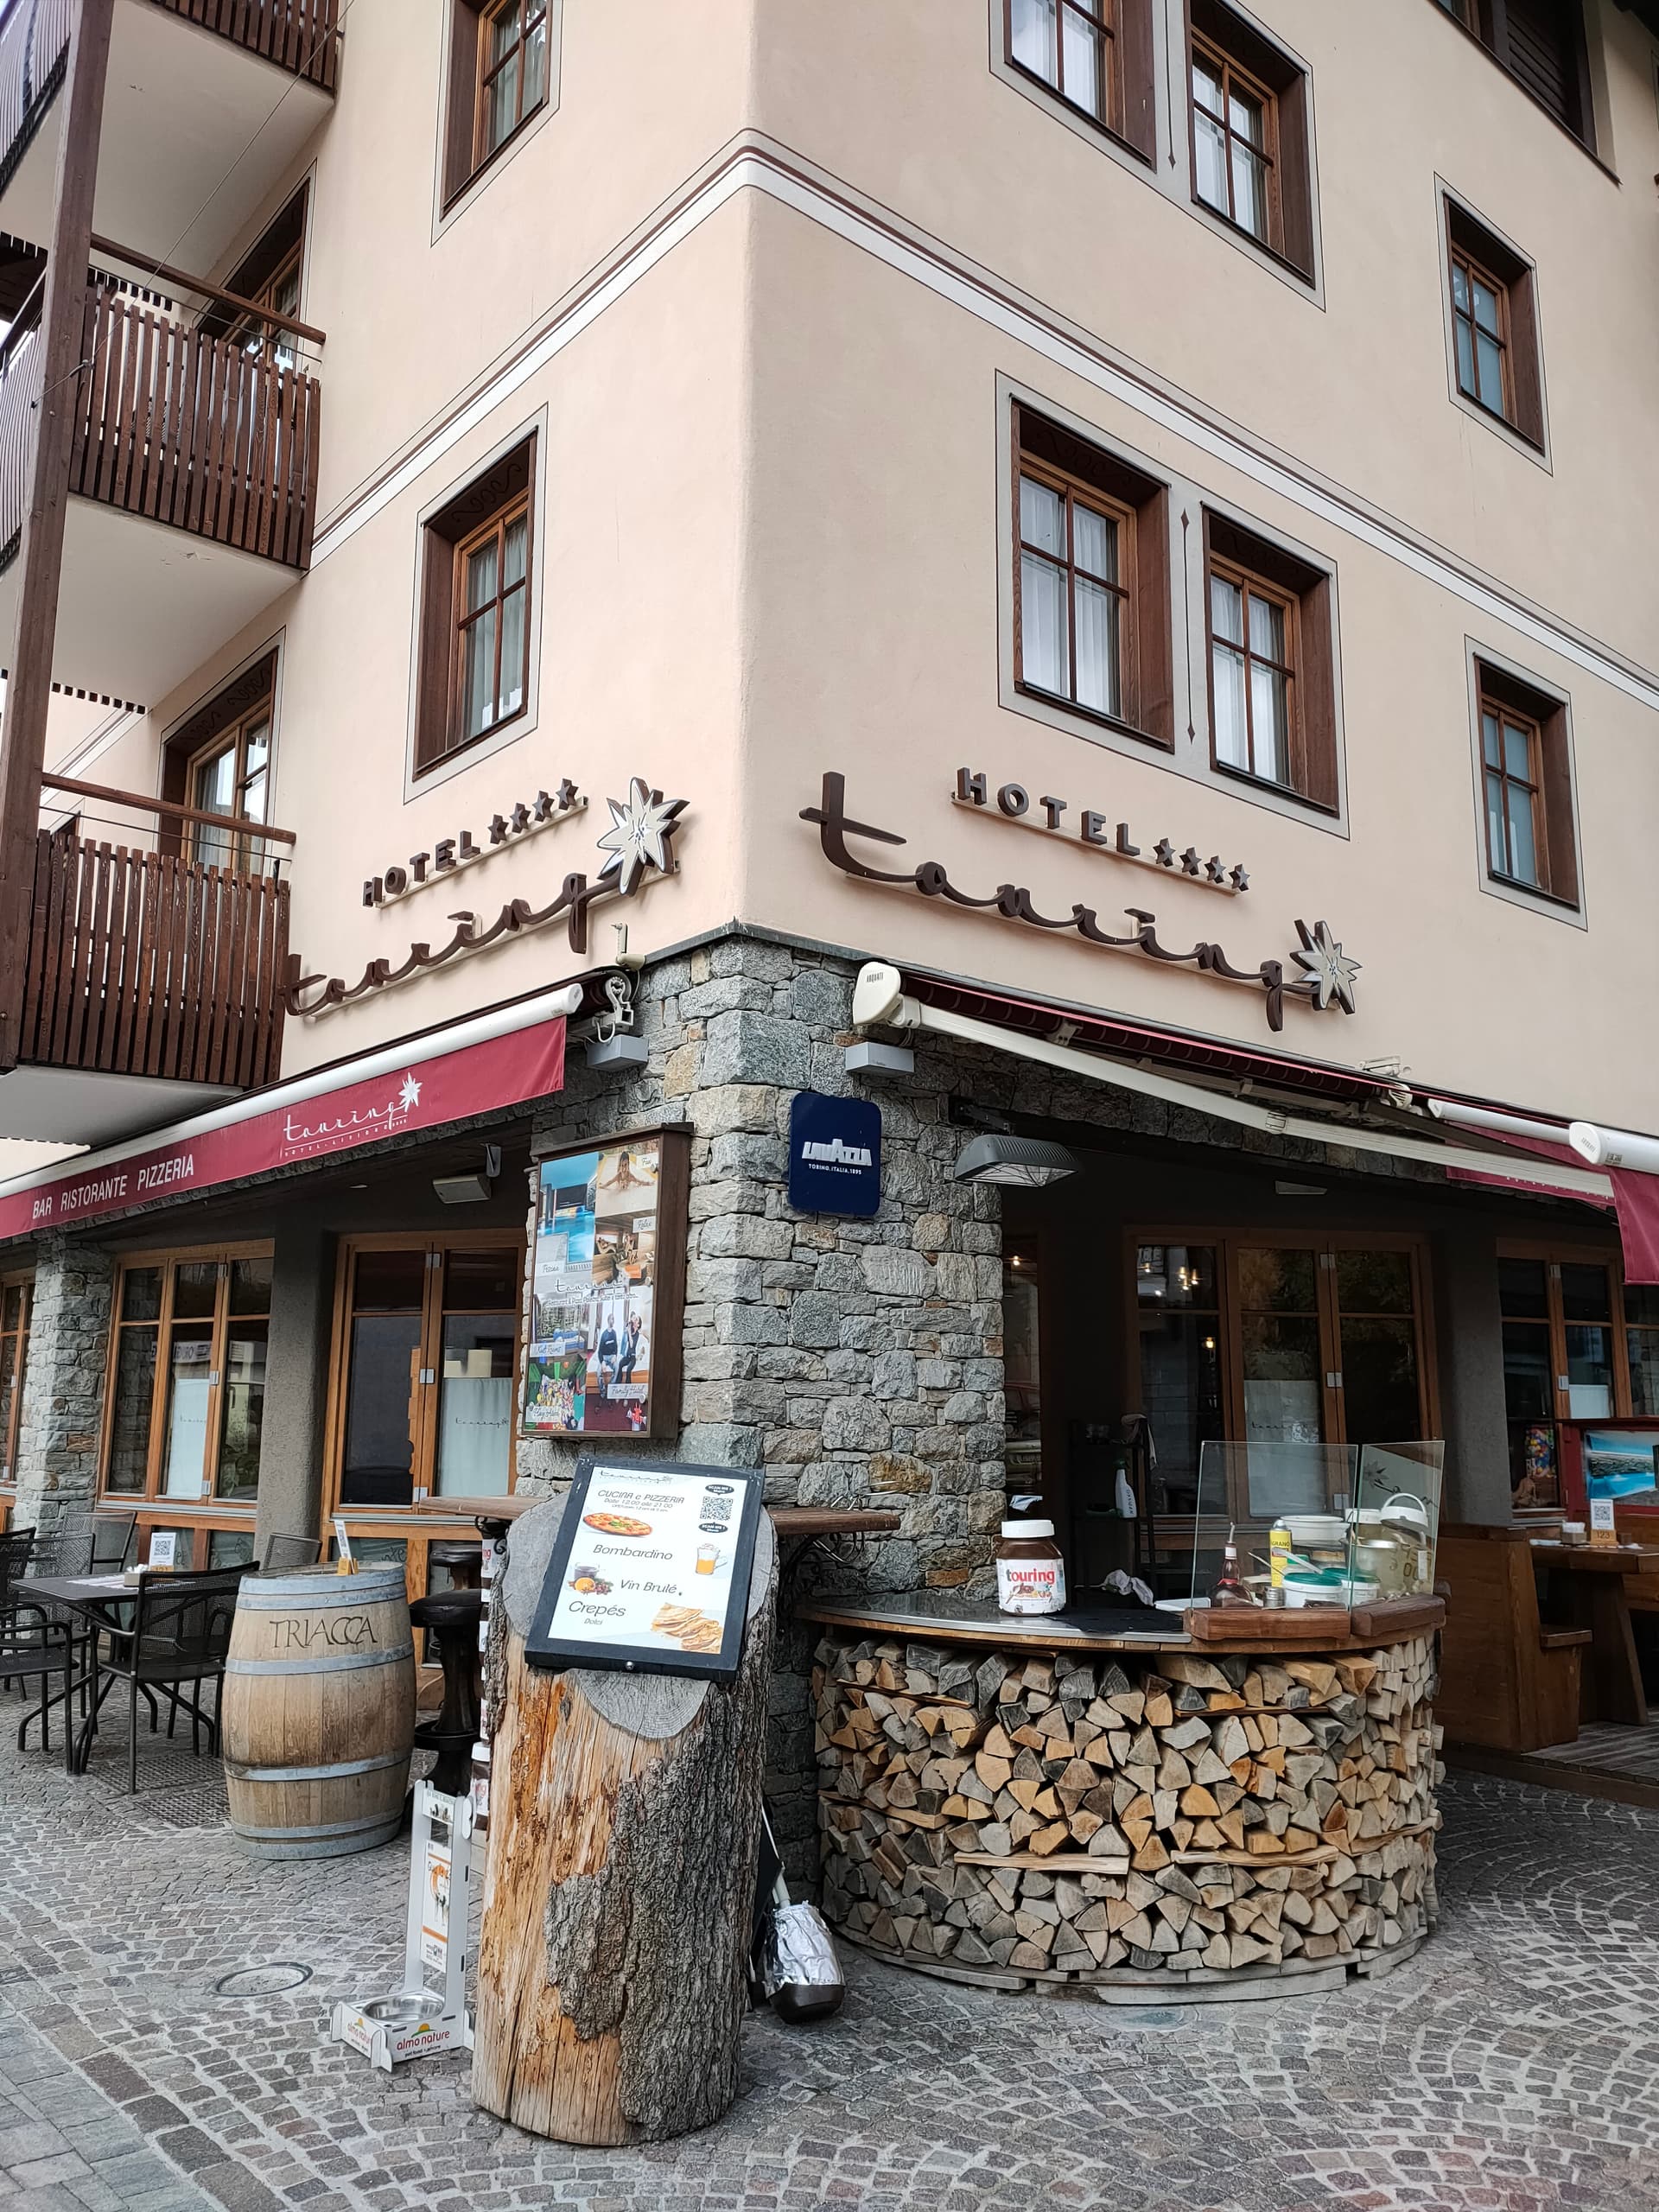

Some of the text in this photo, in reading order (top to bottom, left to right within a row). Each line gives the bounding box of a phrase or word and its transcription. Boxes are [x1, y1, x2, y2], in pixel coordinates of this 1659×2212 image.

[957, 766, 1141, 856] HOTEL
[363, 830, 481, 907] HOTEL
[798, 772, 1319, 1031] touring
[278, 873, 617, 1017] touring
[283, 1102, 404, 1141] touring
[802, 1138, 873, 1166] LAVAZZA
[33, 1154, 194, 1219] BAR RISTORANTE PIZZERIA
[598, 1490, 633, 1499] CUCINA
[644, 1494, 685, 1504] PIZZERIA
[593, 1544, 673, 1560] Bombardino
[620, 1580, 677, 1594] Vin Brulé
[1006, 1568, 1055, 1585] touring
[569, 1600, 626, 1617] Crepés
[269, 1616, 378, 1649] TRIACCA
[397, 2038, 419, 2050] almo
[421, 2031, 449, 2046] nature
